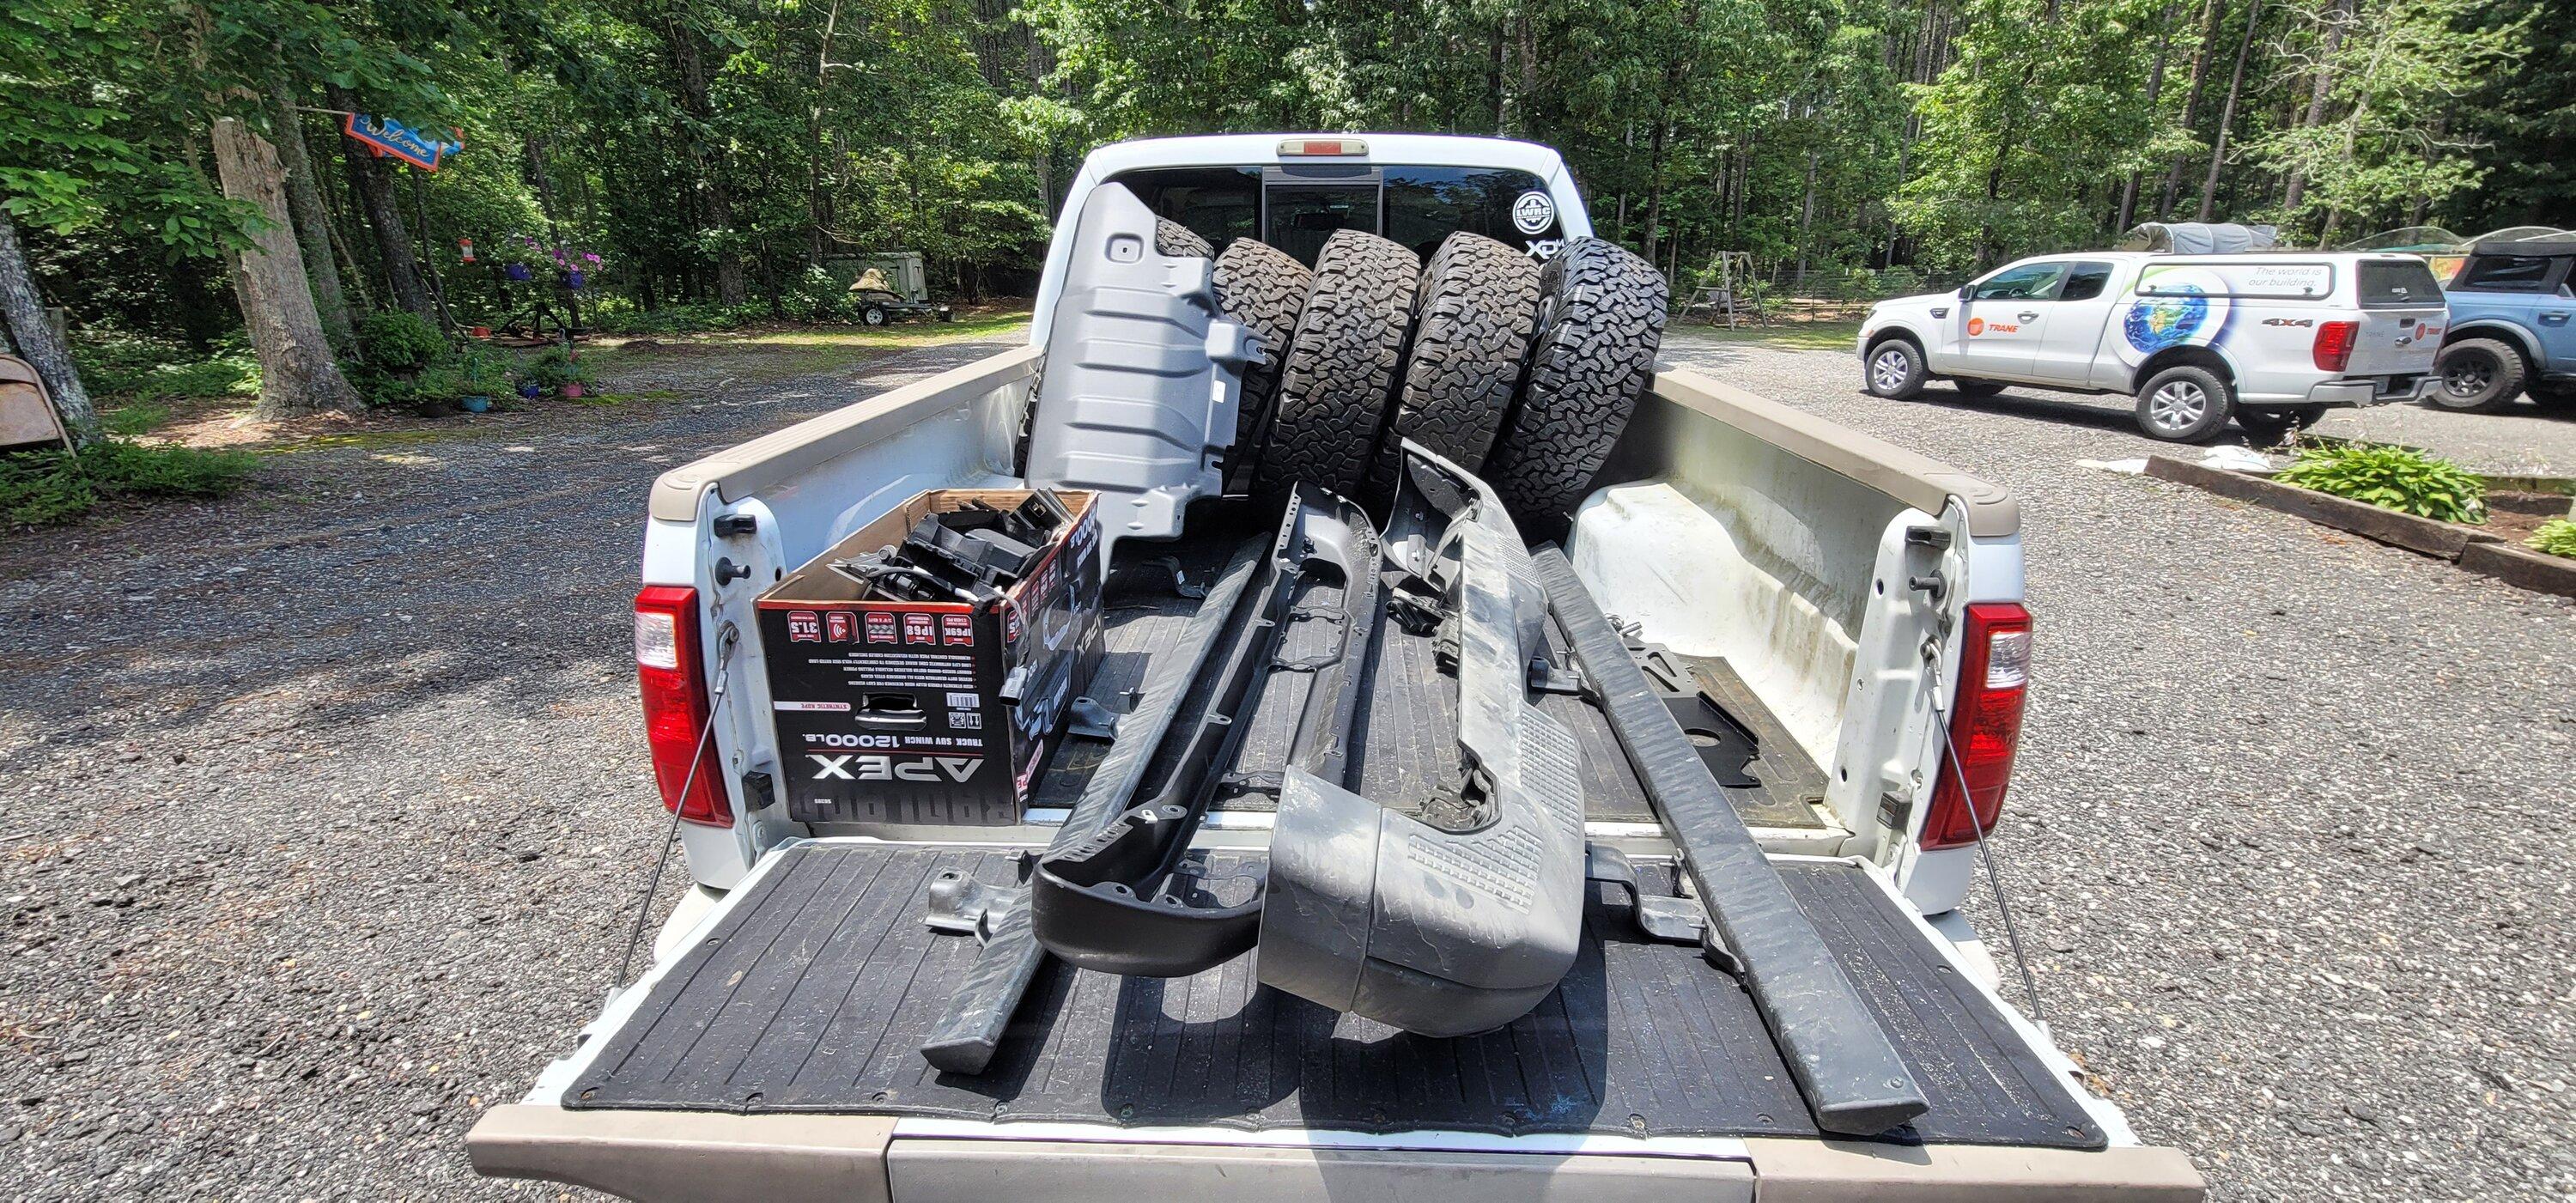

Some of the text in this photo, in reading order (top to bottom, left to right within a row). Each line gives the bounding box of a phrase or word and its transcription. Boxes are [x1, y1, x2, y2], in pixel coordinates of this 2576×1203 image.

[1516, 207, 1551, 216] LWRC
[2255, 266, 2322, 276] The world is
[1989, 324, 2019, 333] TRANE
[791, 622, 817, 634] 31.5
[907, 625, 933, 636] IP68
[945, 628, 971, 636] IP69K
[904, 736, 933, 746] WINCH
[935, 737, 952, 746] SUV
[956, 737, 983, 747] TRUCK
[809, 755, 985, 783] APEX
